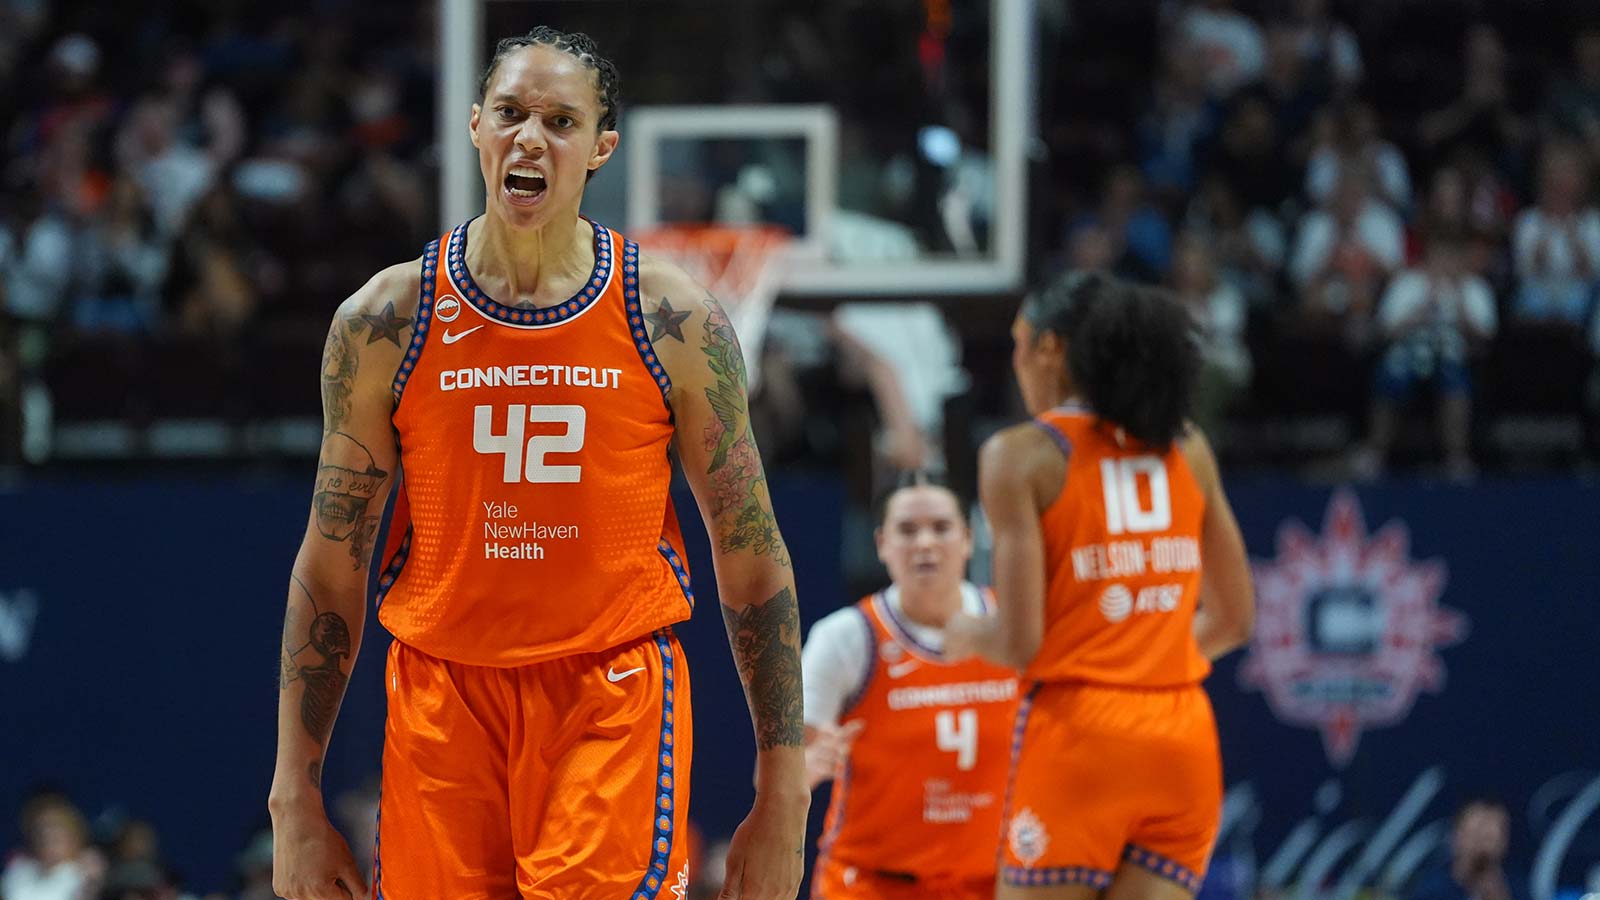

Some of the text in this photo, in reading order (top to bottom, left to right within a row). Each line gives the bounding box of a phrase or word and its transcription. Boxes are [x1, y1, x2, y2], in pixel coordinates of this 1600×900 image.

[440, 364, 622, 391] CONNECTICUT
[473, 404, 586, 483] 42
[327, 478, 343, 489] no
[1100, 456, 1172, 534] 10
[483, 501, 518, 518] Yale
[484, 522, 579, 539] NewHaven
[485, 542, 544, 560] Health
[935, 709, 977, 771] 4
